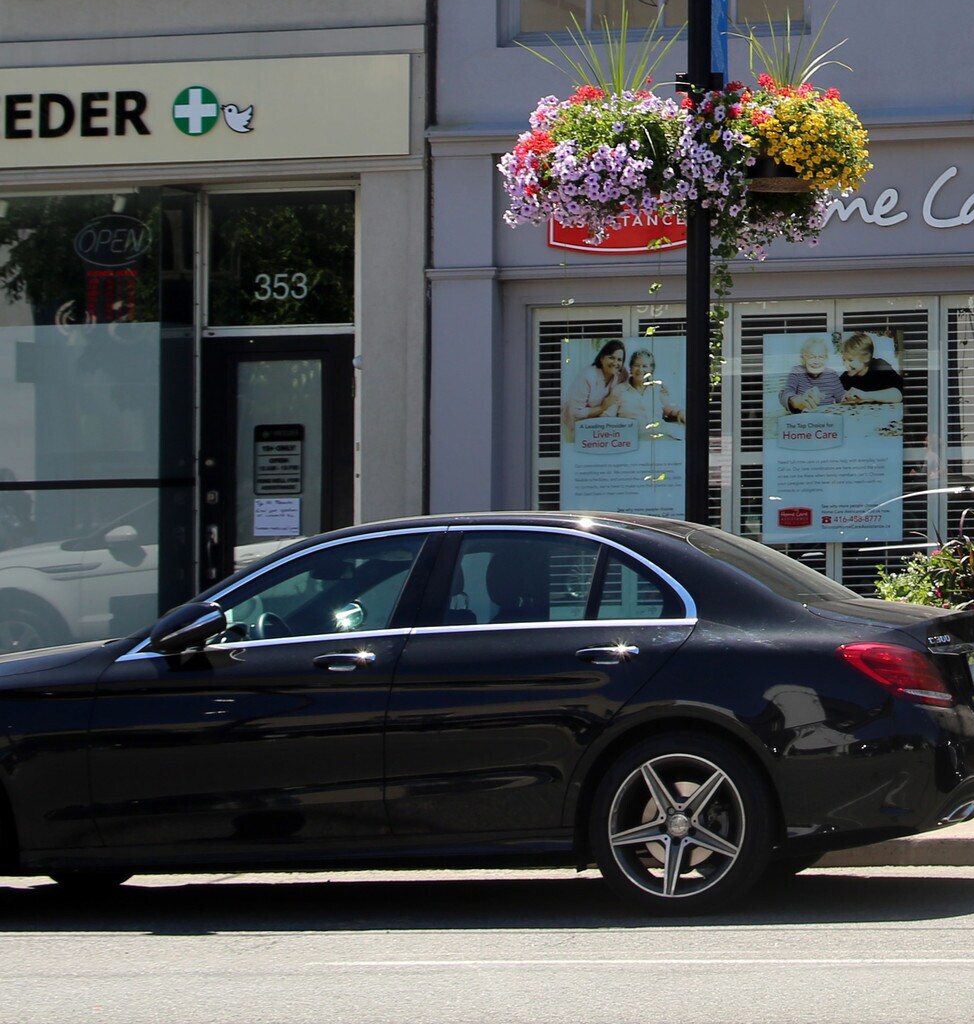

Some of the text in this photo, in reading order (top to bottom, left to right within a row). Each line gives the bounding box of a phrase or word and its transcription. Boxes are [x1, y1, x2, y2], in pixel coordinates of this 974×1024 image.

[78, 228, 144, 254] OPEN
[253, 272, 309, 301] 353
[592, 430, 620, 439] Live-in
[782, 429, 838, 440] Home Care
[582, 439, 631, 449] Senior Care
